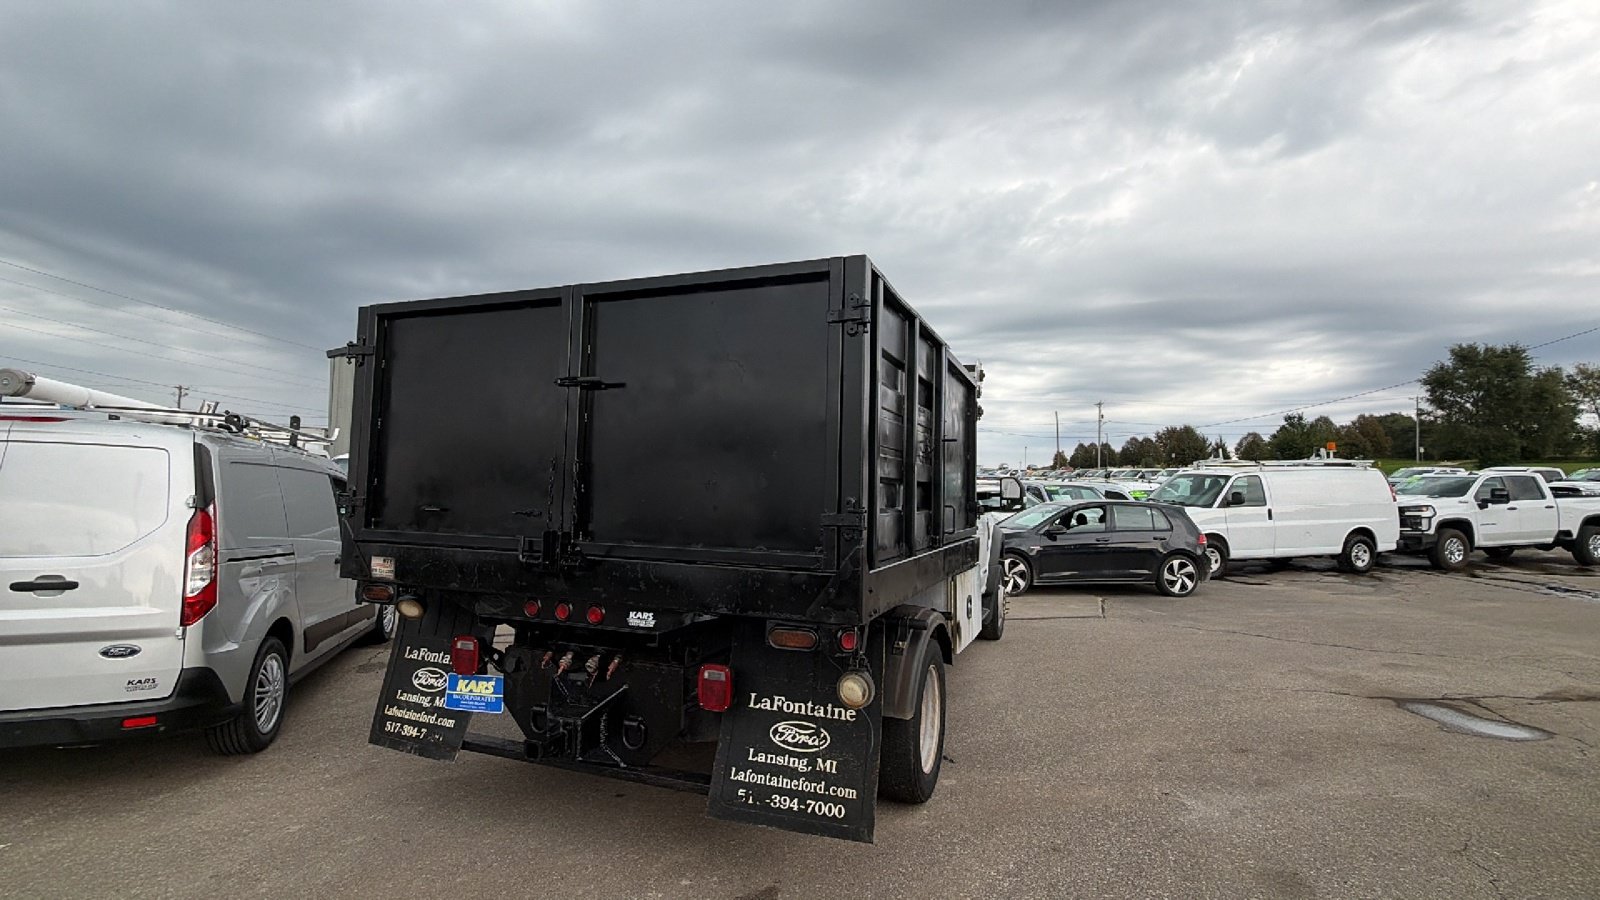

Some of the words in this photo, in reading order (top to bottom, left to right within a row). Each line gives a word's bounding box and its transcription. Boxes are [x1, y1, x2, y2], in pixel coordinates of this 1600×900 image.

[629, 611, 654, 620] KARS
[415, 671, 446, 687] Ford
[457, 679, 496, 694] KARS
[384, 704, 456, 728] Lafontaineford.com
[748, 693, 856, 721] LaFontaine
[748, 748, 812, 772] Lansing,
[816, 757, 838, 774] MI
[730, 767, 857, 799] Lafontaineford.com
[738, 789, 846, 819] 51-394-7000
